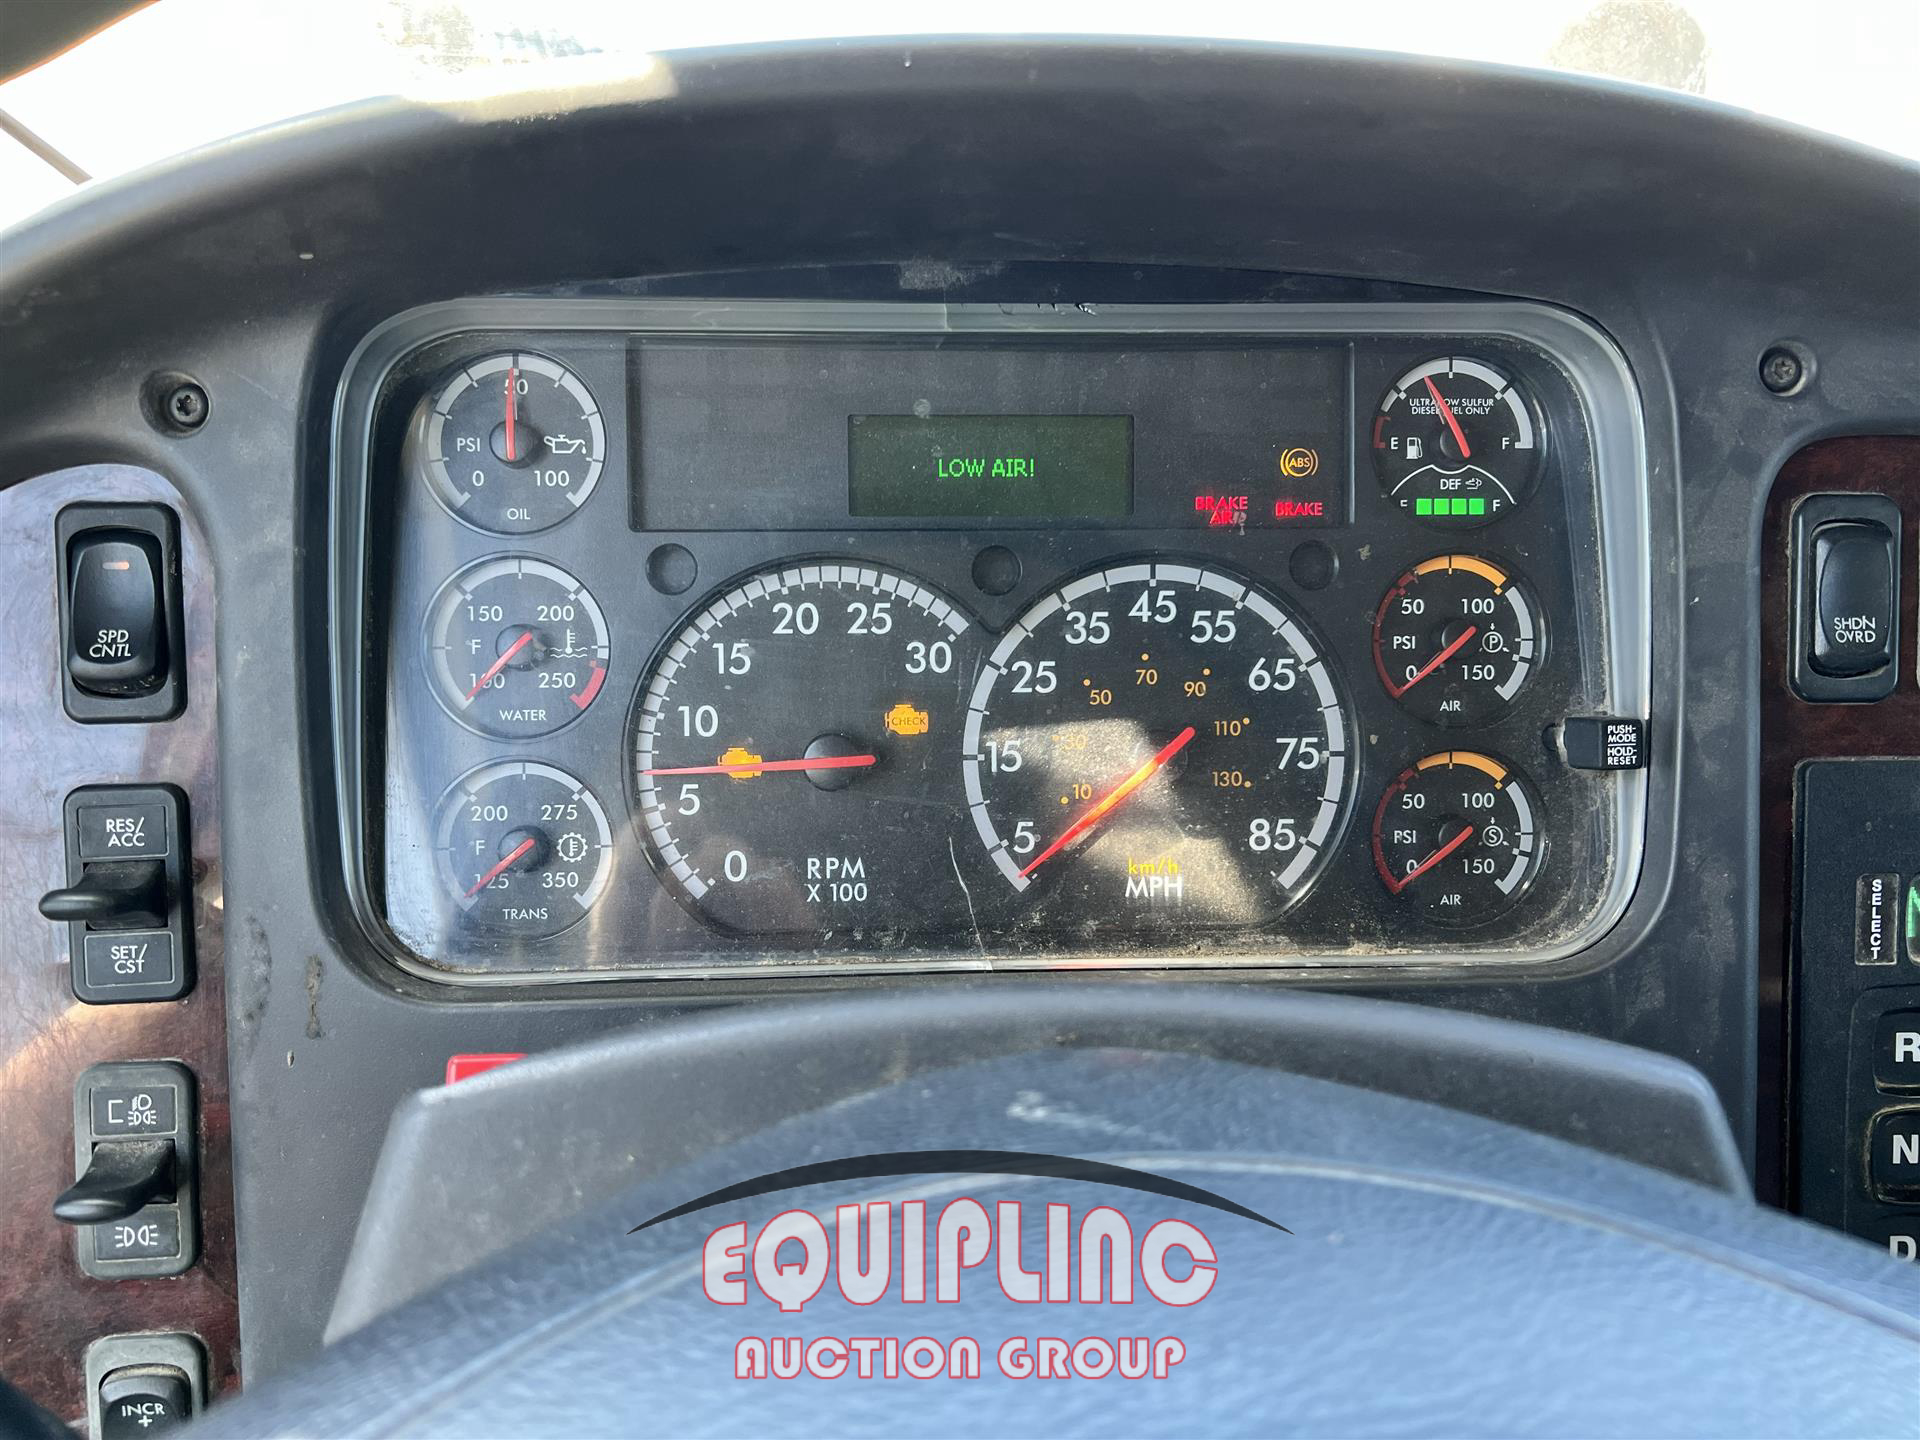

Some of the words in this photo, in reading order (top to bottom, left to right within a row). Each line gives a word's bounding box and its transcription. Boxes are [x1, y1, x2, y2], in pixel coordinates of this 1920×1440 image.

[1409, 398, 1437, 407] ULTRA
[1461, 398, 1494, 407] SULFUR
[1465, 407, 1490, 415] ONLY
[457, 438, 480, 452] PSI
[1391, 437, 1399, 450] E
[1502, 437, 1510, 450] F
[938, 458, 985, 478] LOW
[992, 458, 1035, 478] AIR!
[1289, 457, 1311, 468] ABS
[472, 470, 485, 487] 0
[534, 470, 570, 487] 100
[1440, 478, 1462, 490] DEF
[1195, 496, 1249, 511] BRAKE
[1276, 502, 1323, 517] BRAKE
[1492, 500, 1500, 512] F
[507, 508, 531, 520] OIL
[467, 605, 504, 622] 150
[537, 605, 575, 622] 200
[1128, 590, 1177, 624] 45
[1401, 599, 1425, 615] 50
[1461, 599, 1495, 615] 100
[772, 602, 819, 635] 20
[847, 602, 893, 635] 25
[1190, 610, 1237, 643] 55
[1833, 615, 1876, 631] SHDN
[97, 629, 129, 643] SPD
[1064, 611, 1111, 645] 35
[1393, 635, 1416, 650] PSI
[1835, 630, 1876, 644] OVRD
[89, 644, 131, 658] CNTL
[471, 639, 481, 654] F
[712, 642, 751, 675] 15
[905, 641, 952, 674] 30
[538, 672, 576, 688] 250
[1011, 661, 1058, 694] 25
[1135, 669, 1158, 686] 70
[1248, 657, 1296, 692] 65
[1406, 664, 1418, 680] 0
[1462, 664, 1495, 680] 150
[1089, 689, 1112, 706] 50
[1184, 681, 1207, 698] 90
[1440, 701, 1461, 712] AIR
[500, 709, 547, 721] WATER
[677, 705, 719, 738] 10
[891, 715, 926, 726] CHECK
[1214, 720, 1241, 737] 110
[1607, 724, 1636, 734] PUSH-
[1607, 733, 1637, 743] MODE
[985, 741, 1022, 773] 15
[1276, 737, 1320, 770] 75
[1607, 746, 1637, 756] HOLD-
[1607, 755, 1638, 765] RESET
[1212, 771, 1243, 788] 130
[678, 783, 701, 816] 5
[1072, 784, 1092, 801] 10
[1401, 793, 1425, 809] 50
[1461, 793, 1495, 809] 100
[471, 805, 508, 821] 200
[541, 804, 578, 821] 275
[106, 816, 145, 834] RES/
[107, 833, 145, 847] ACC
[1013, 821, 1035, 853] 5
[1248, 818, 1296, 852] 85
[1393, 830, 1416, 844] PSI
[475, 840, 485, 855] F
[723, 850, 748, 882] 0
[807, 857, 866, 879] RPM
[1128, 857, 1179, 875] km/h
[1406, 859, 1418, 874] 0
[1462, 859, 1495, 874] 150
[542, 872, 579, 888] 350
[1124, 876, 1183, 898] MPH
[806, 884, 821, 902] X
[831, 883, 868, 902] 100
[1440, 894, 1461, 906] AIR
[502, 907, 548, 920] TRANS
[1870, 878, 1882, 960] SELECT
[111, 943, 148, 961] SET/
[114, 960, 145, 974] CST
[1895, 1032, 1920, 1063] R
[1892, 1134, 1919, 1164] N
[1889, 1235, 1917, 1263] D
[121, 1402, 165, 1417] INCR
